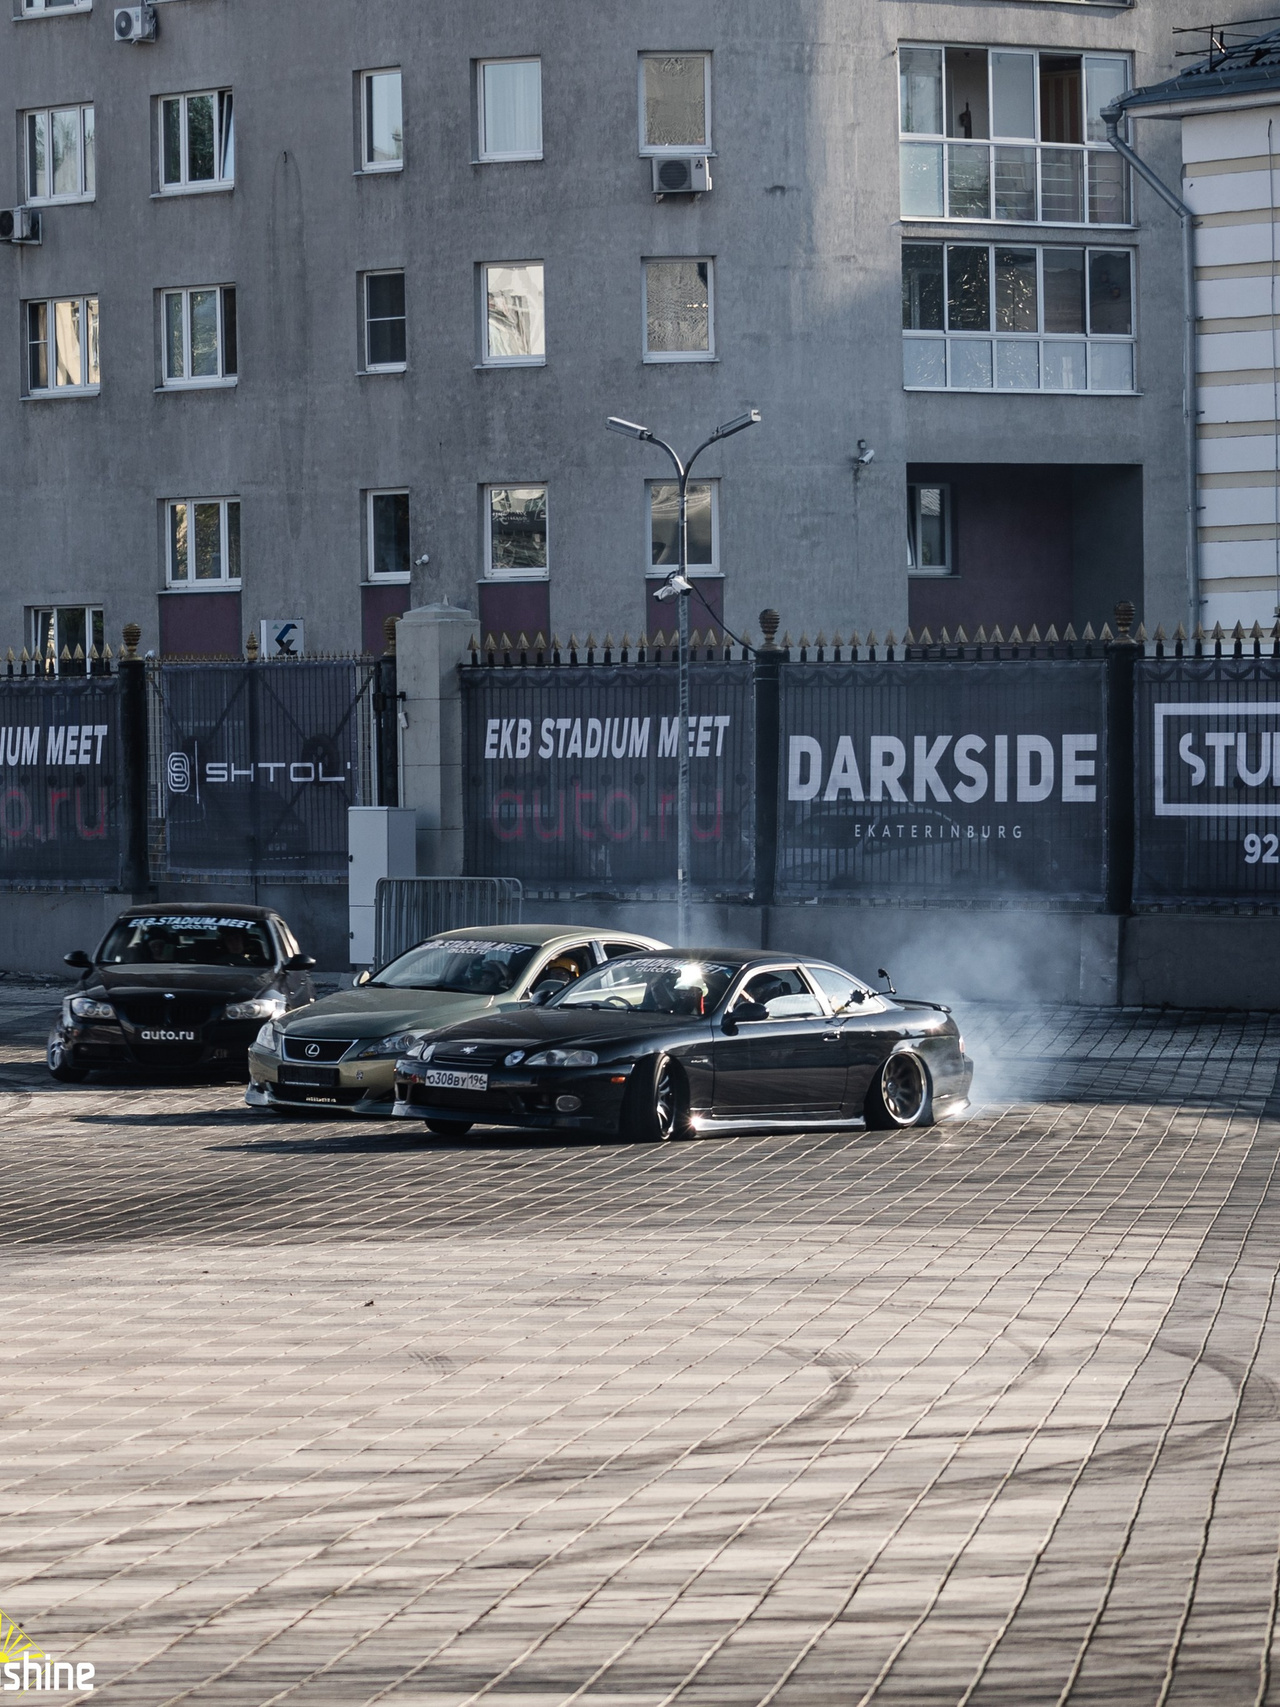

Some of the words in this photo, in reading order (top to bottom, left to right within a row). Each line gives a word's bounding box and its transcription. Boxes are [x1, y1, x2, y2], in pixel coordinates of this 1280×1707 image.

[46, 724, 108, 765] MEET
[484, 718, 532, 759] EKB
[537, 717, 651, 759] STADIUM
[787, 733, 1098, 804] DARKSIDE
[491, 779, 723, 843] auto.ru
[853, 823, 1023, 839] EKATERINBURG
[141, 1027, 195, 1041] auto.ru
[468, 1074, 486, 1086] 196
